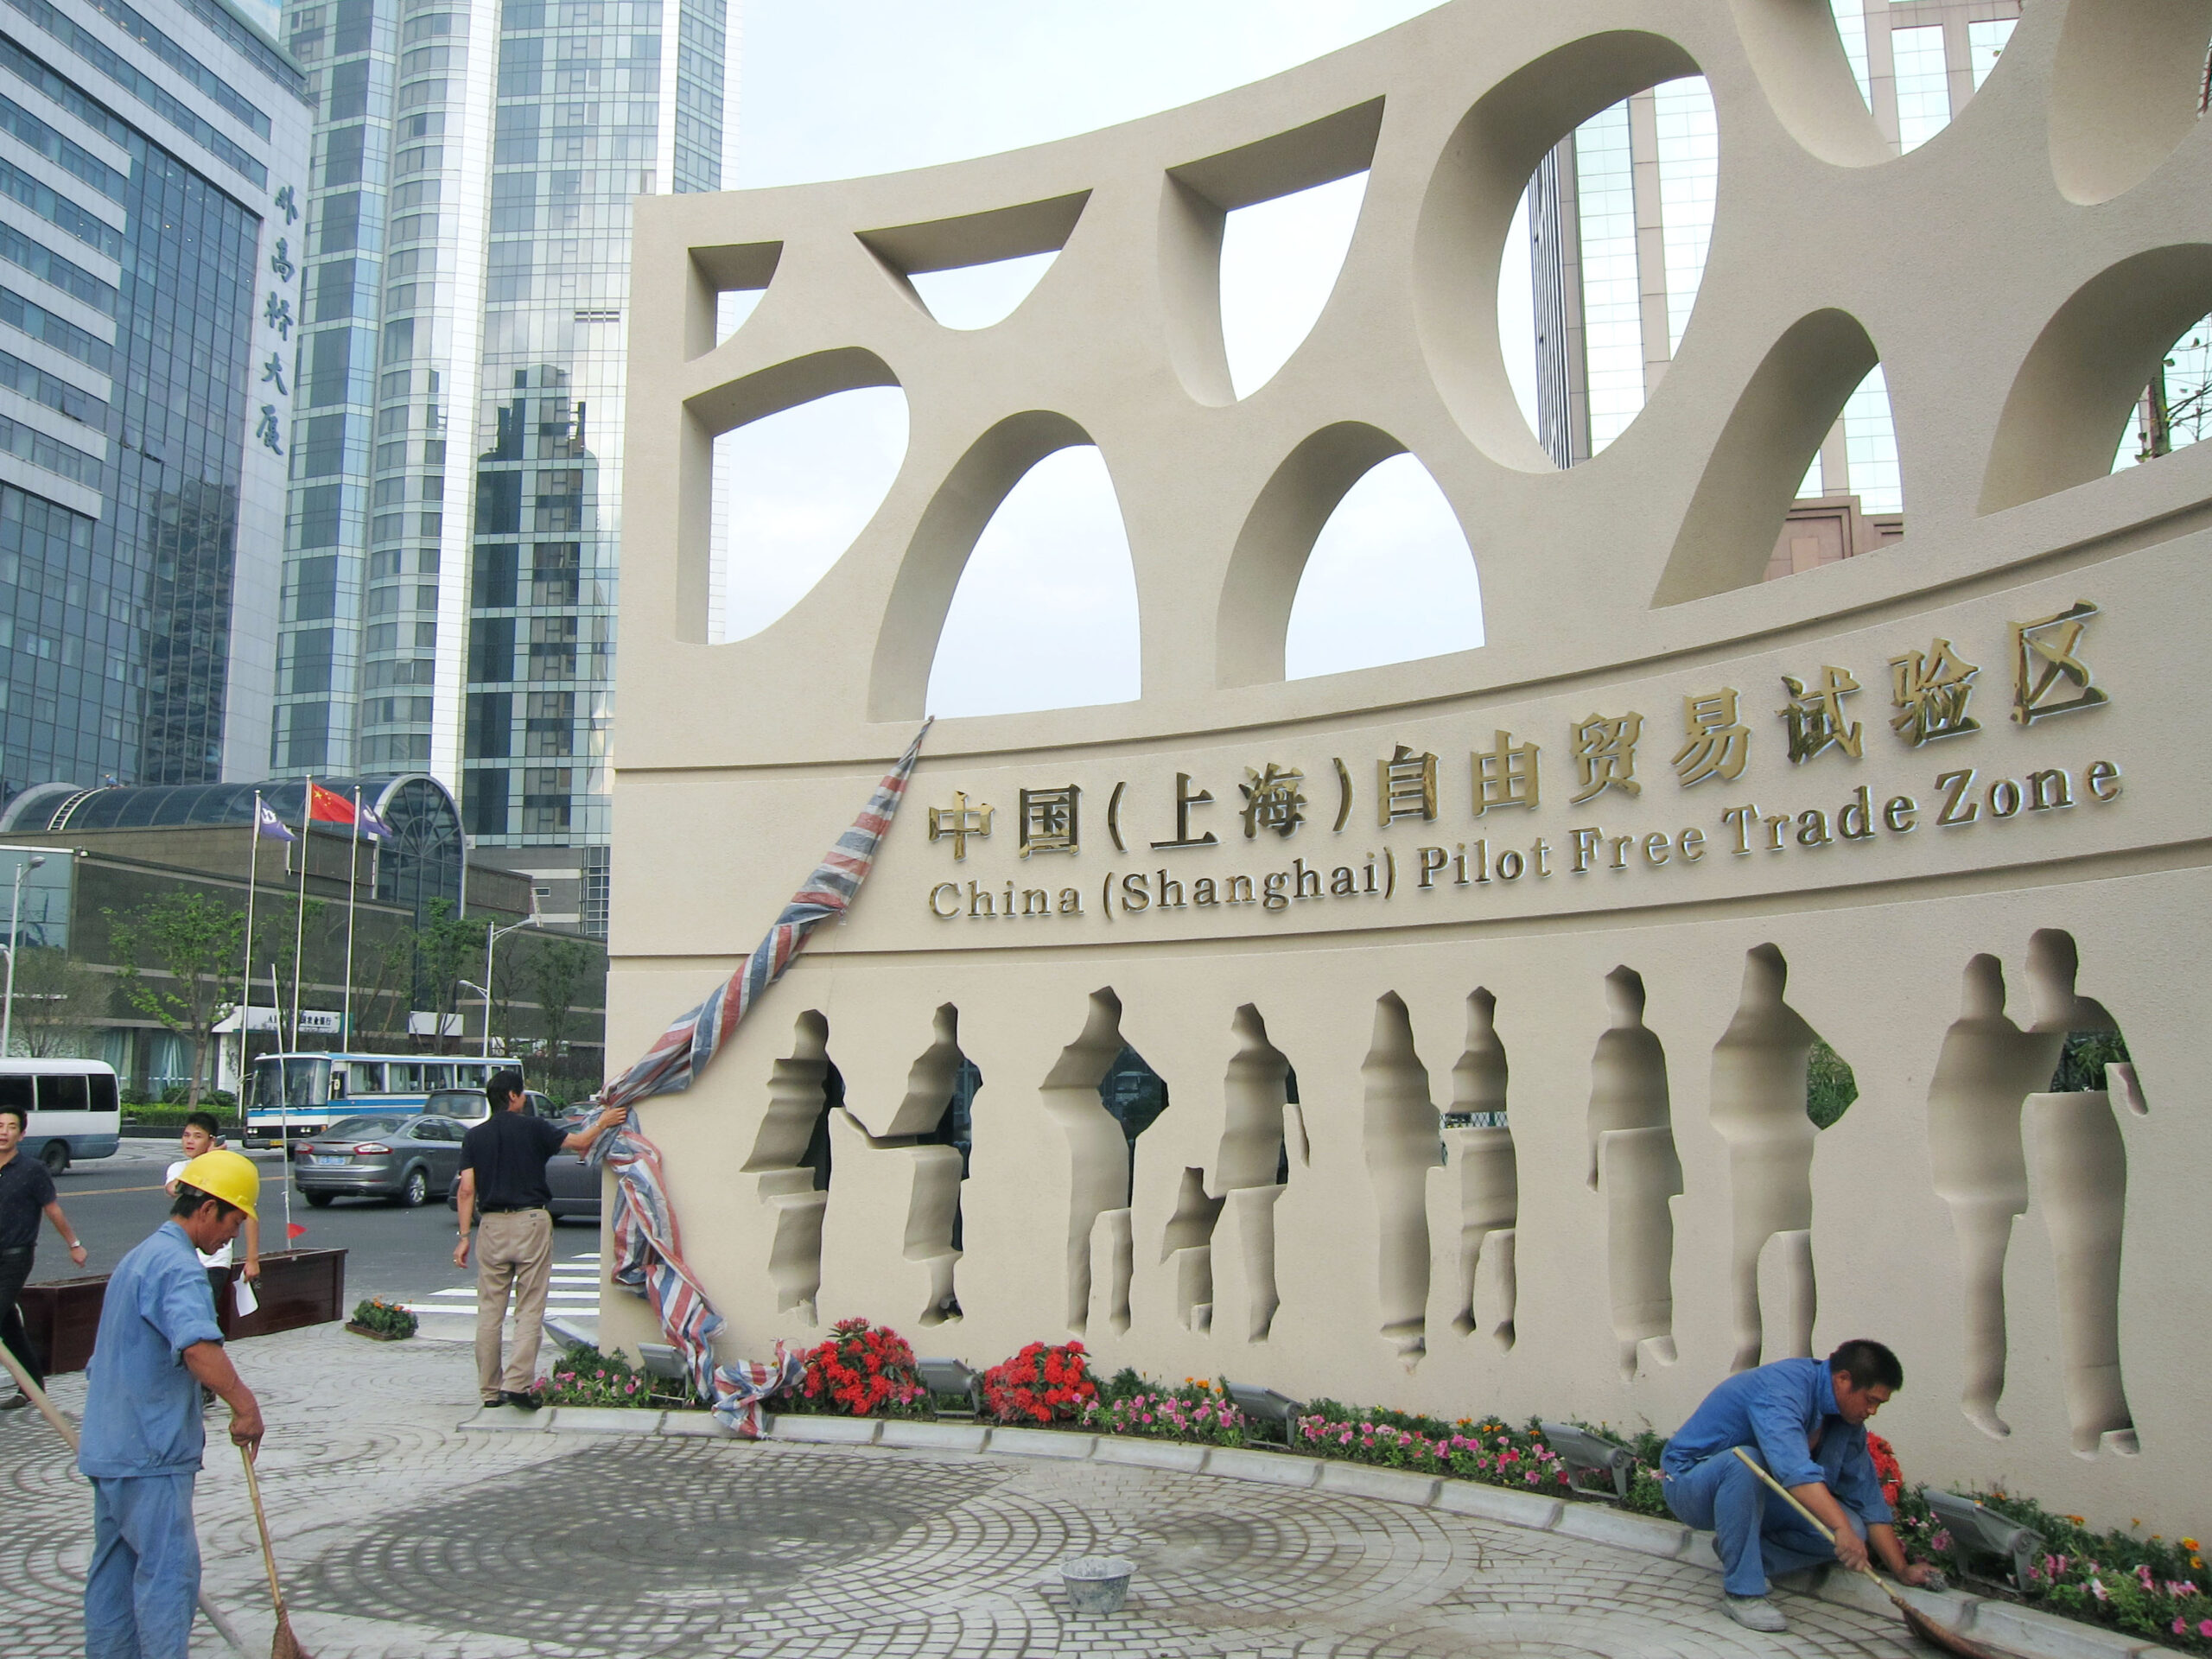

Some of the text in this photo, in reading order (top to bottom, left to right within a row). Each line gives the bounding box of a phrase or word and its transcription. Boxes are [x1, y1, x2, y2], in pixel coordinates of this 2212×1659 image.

[255, 185, 299, 457] 外高桥大厦
[929, 759, 2121, 921] China (Shanghai) Pilot Free Trade Zone
